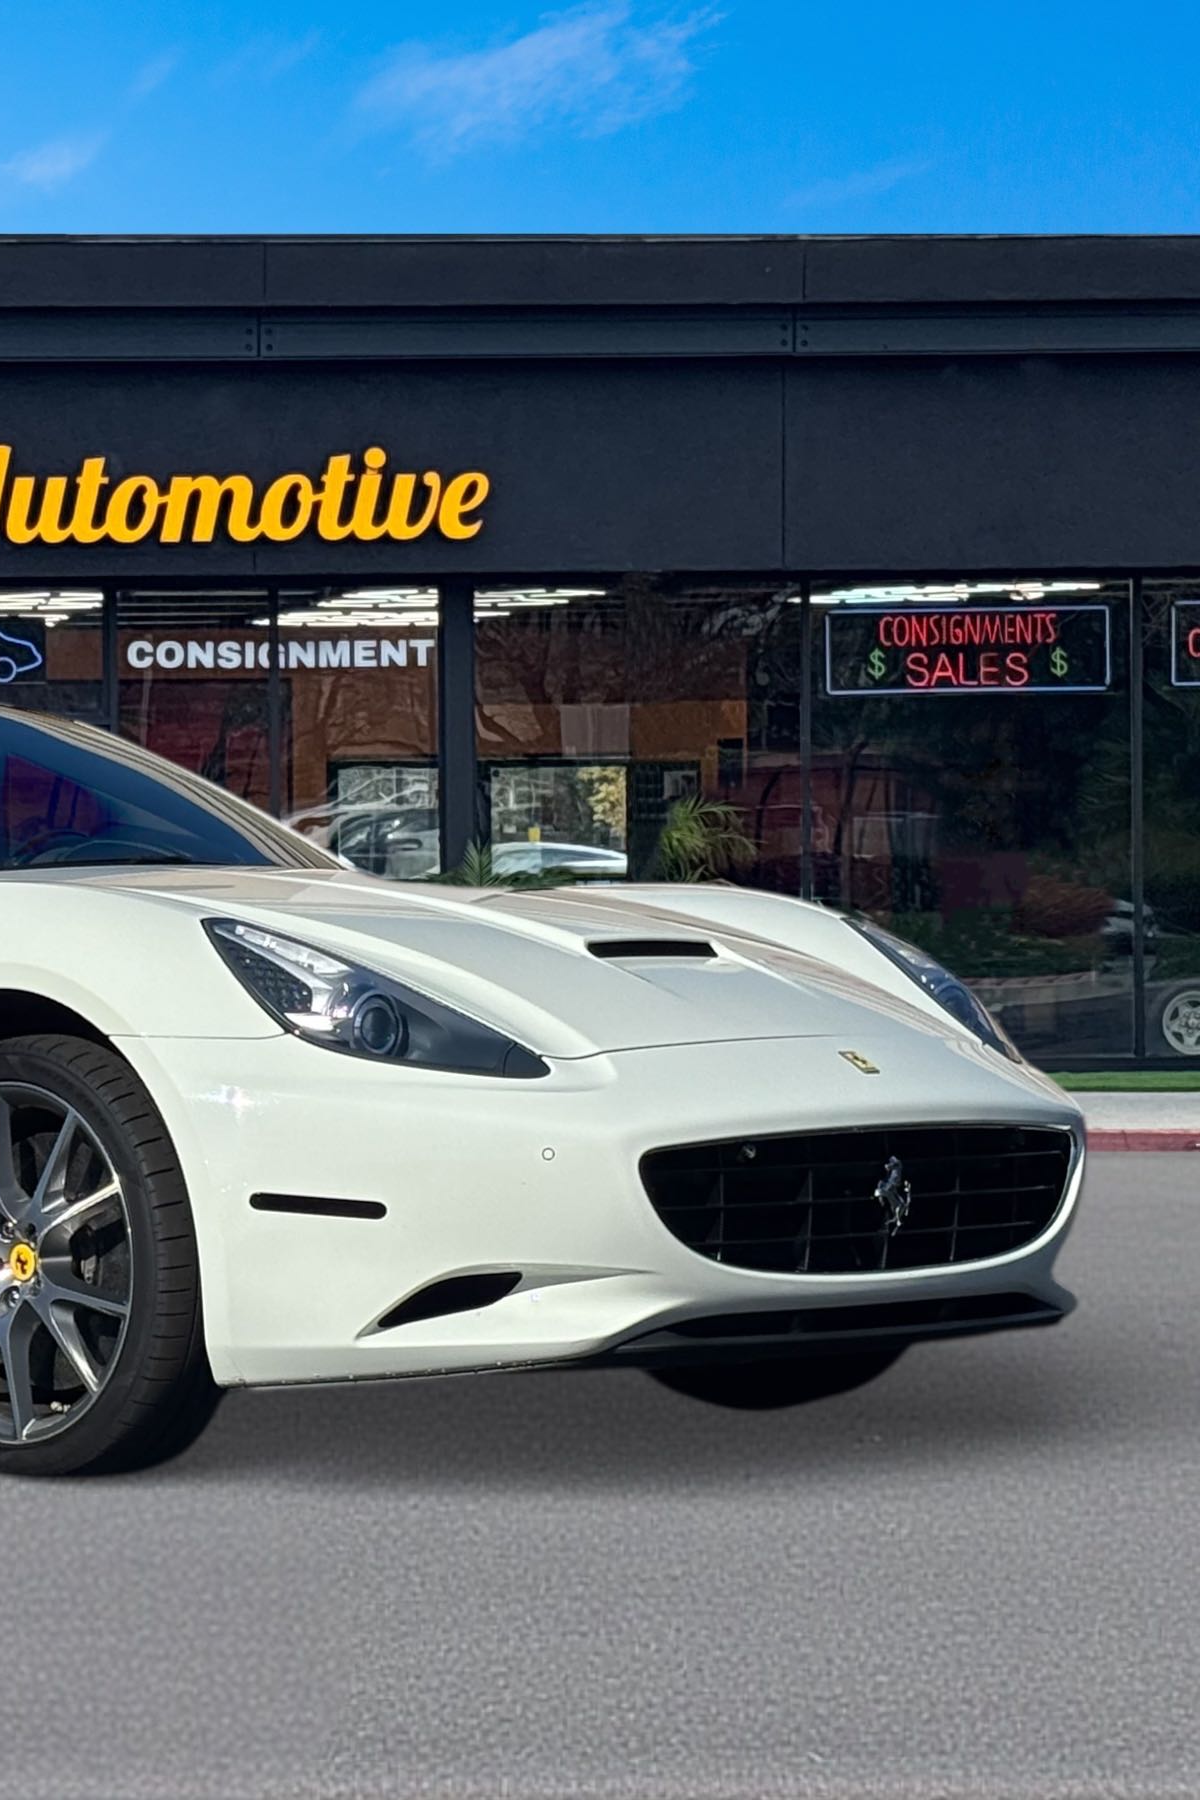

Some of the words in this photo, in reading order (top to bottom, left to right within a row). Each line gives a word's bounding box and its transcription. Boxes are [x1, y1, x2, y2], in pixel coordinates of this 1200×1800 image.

[878, 613, 1058, 647] CONSIGNMENTS
[126, 638, 435, 670] CONSIGNMENT
[905, 652, 1030, 687] SALES
